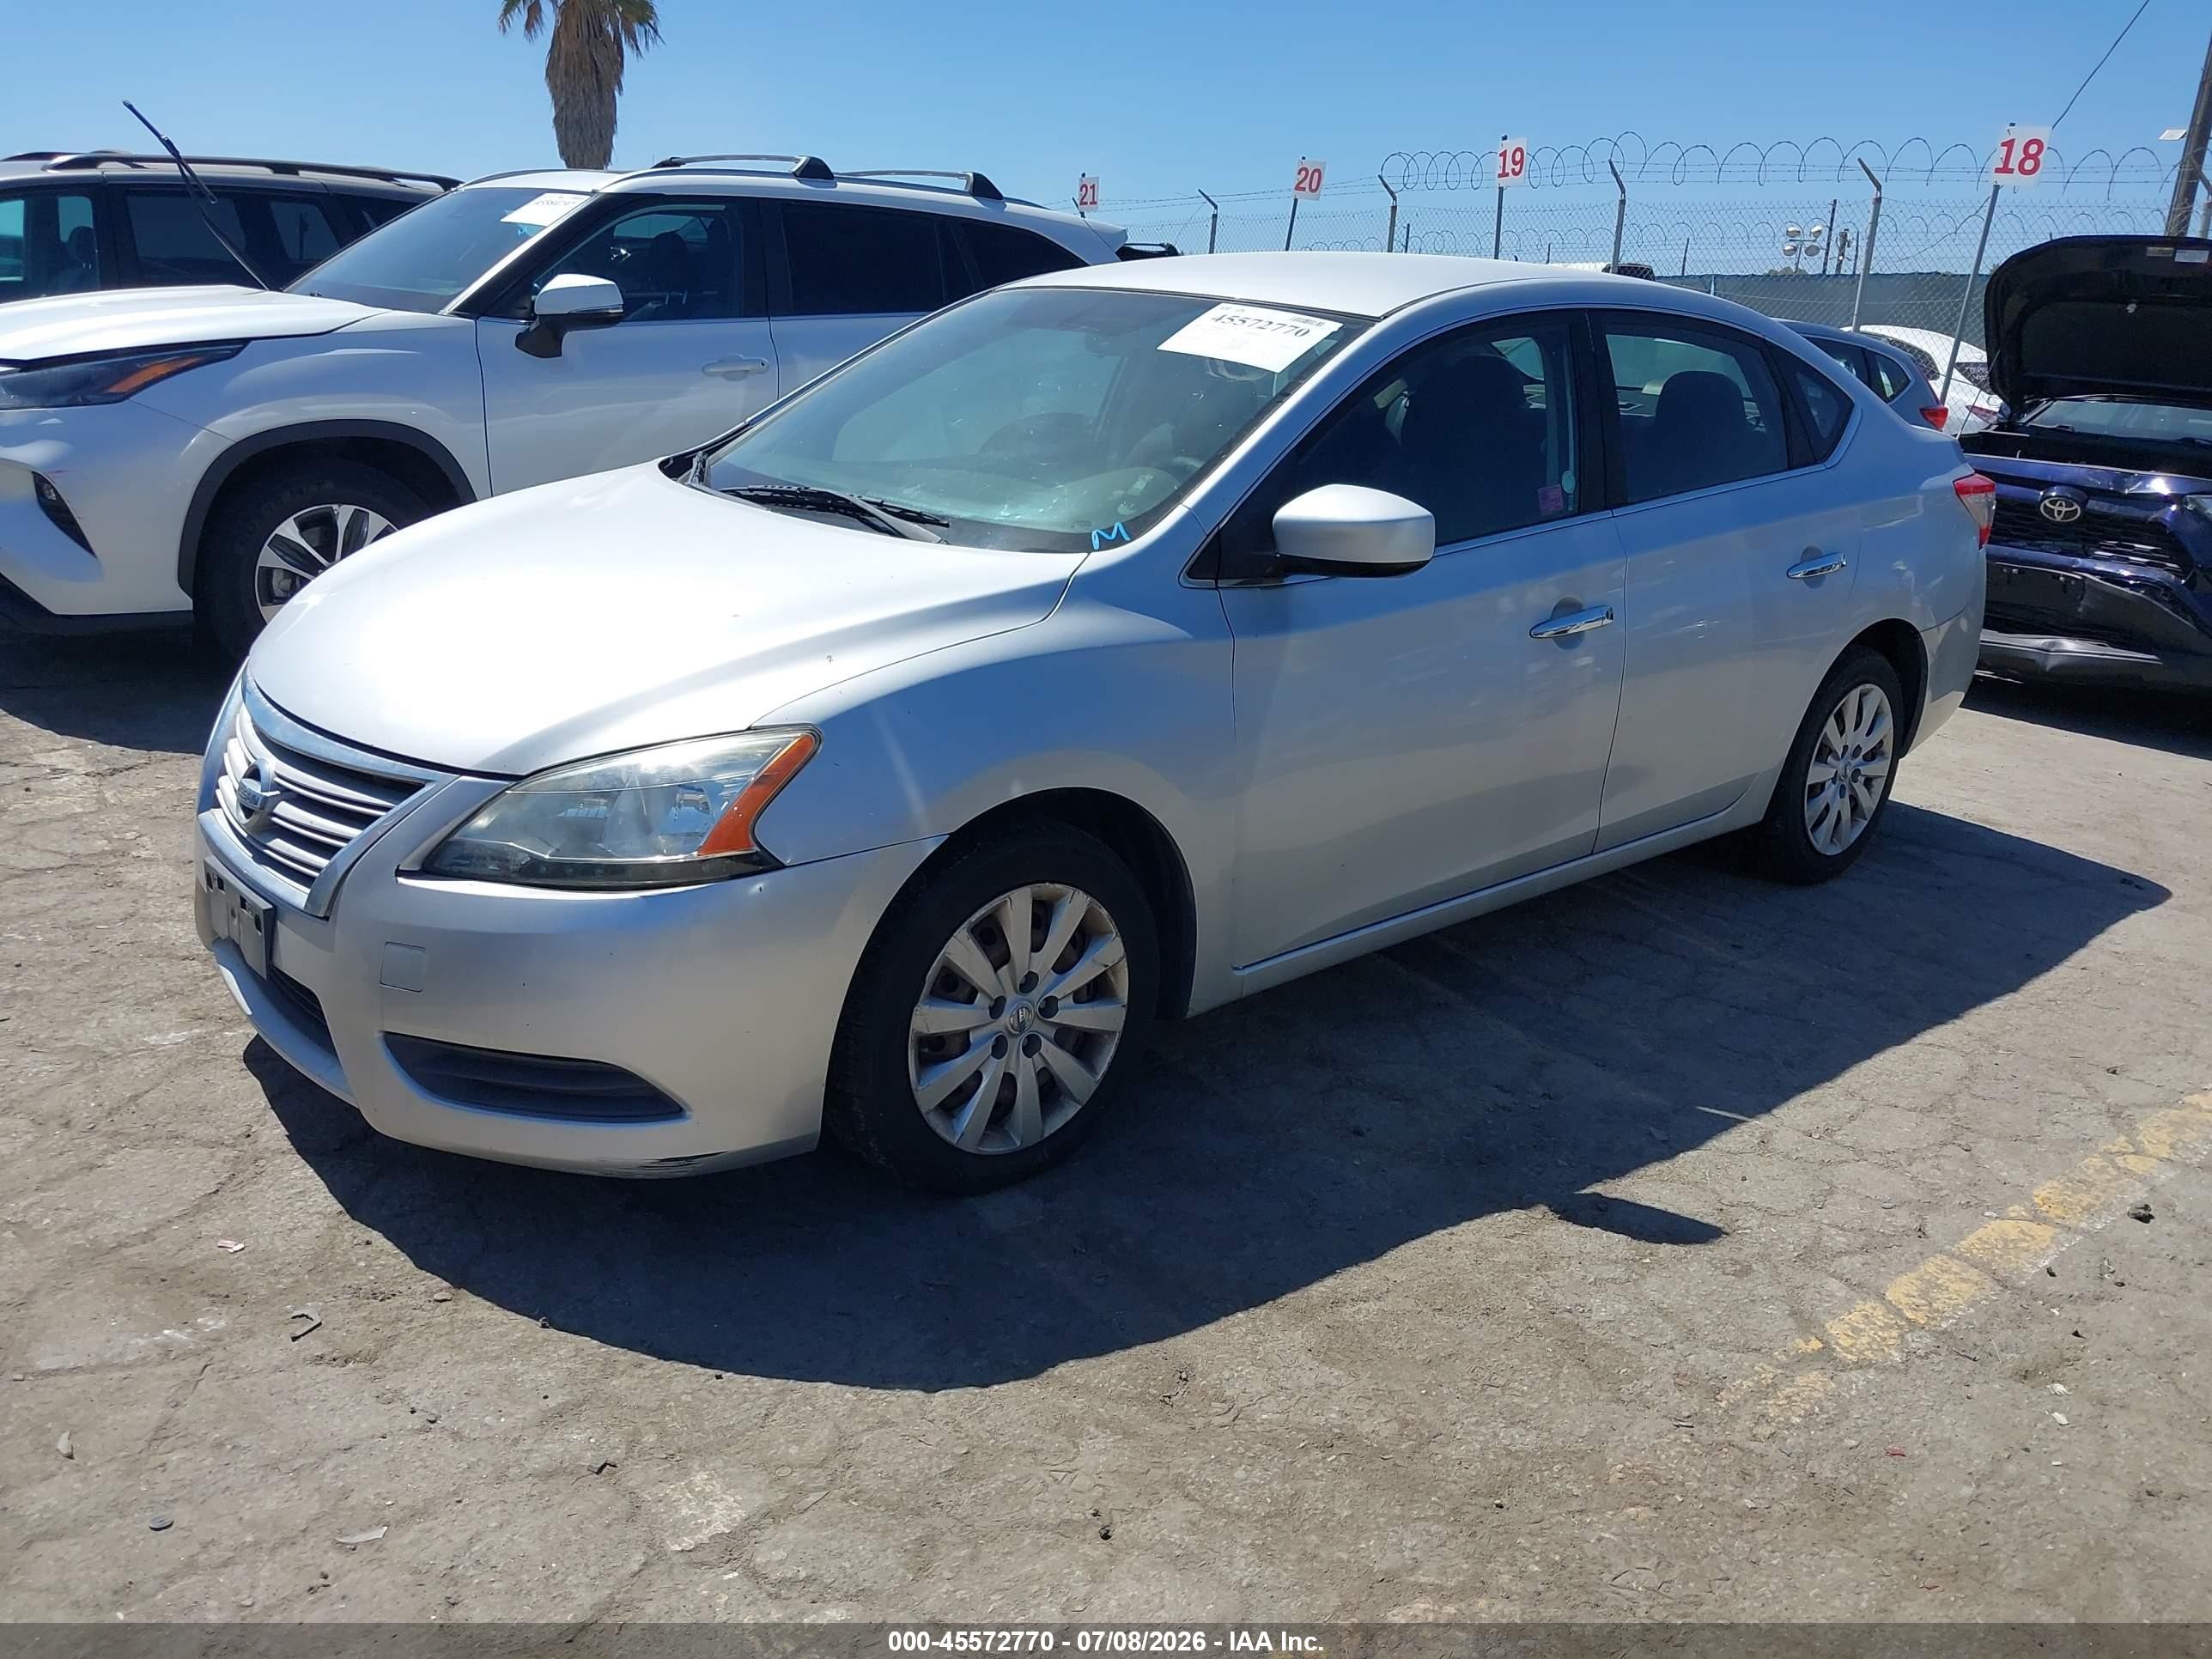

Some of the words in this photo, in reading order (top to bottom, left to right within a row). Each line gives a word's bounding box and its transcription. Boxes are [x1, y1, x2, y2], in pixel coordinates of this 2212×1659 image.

[1497, 147, 1525, 178] 19
[1993, 138, 2045, 176] 18
[1294, 167, 1322, 193] 20
[1079, 183, 1097, 206] 21
[1210, 314, 1310, 337] 45572770
[1091, 521, 1131, 550] M
